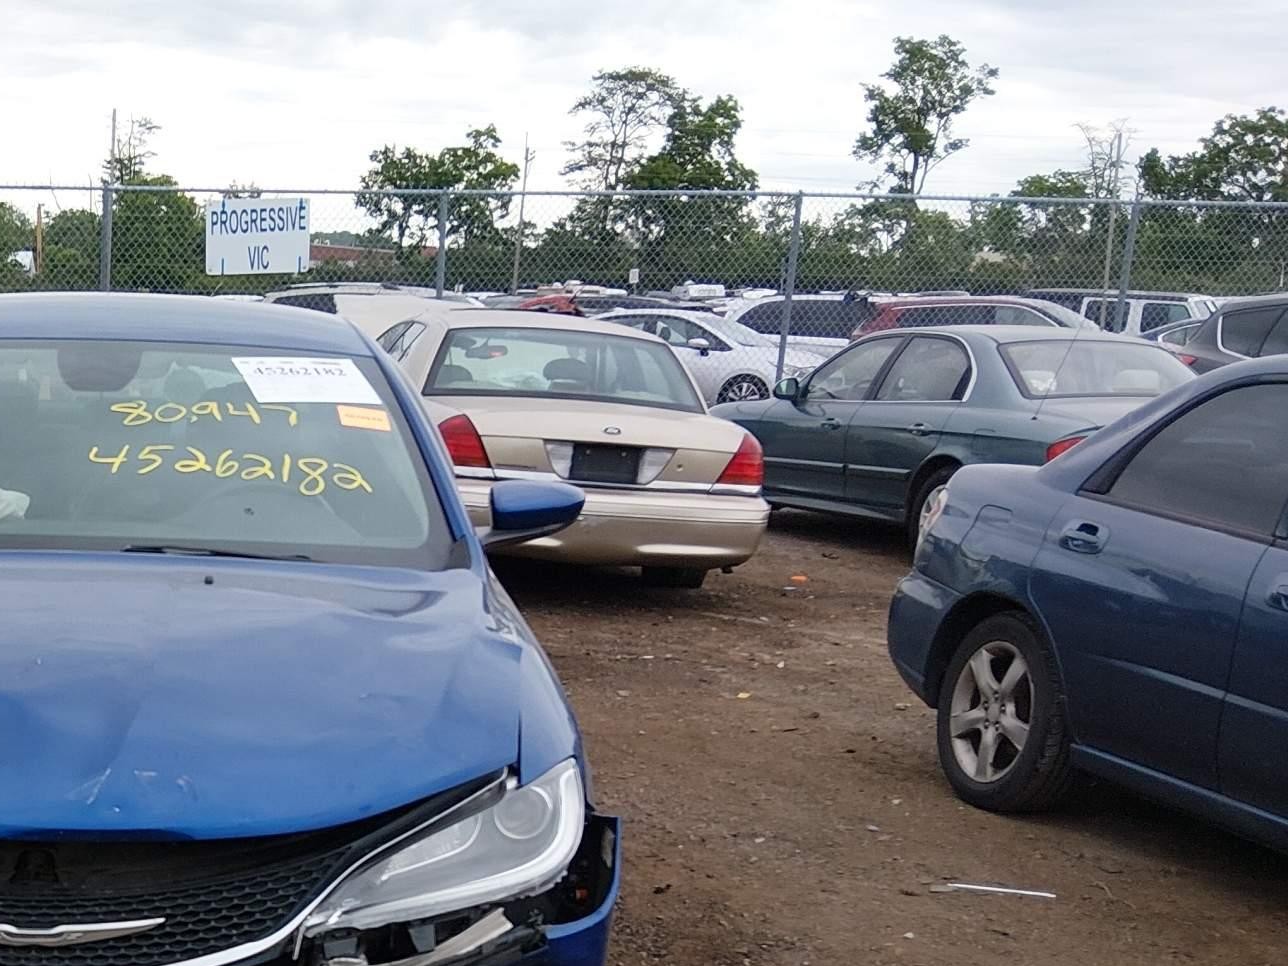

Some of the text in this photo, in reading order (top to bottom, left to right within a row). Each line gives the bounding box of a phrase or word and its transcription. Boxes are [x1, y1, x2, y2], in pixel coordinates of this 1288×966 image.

[211, 205, 306, 236] PROGRESSIVE
[247, 245, 270, 271] VIC
[253, 366, 348, 377] 45262182
[88, 444, 373, 496] 45262182
